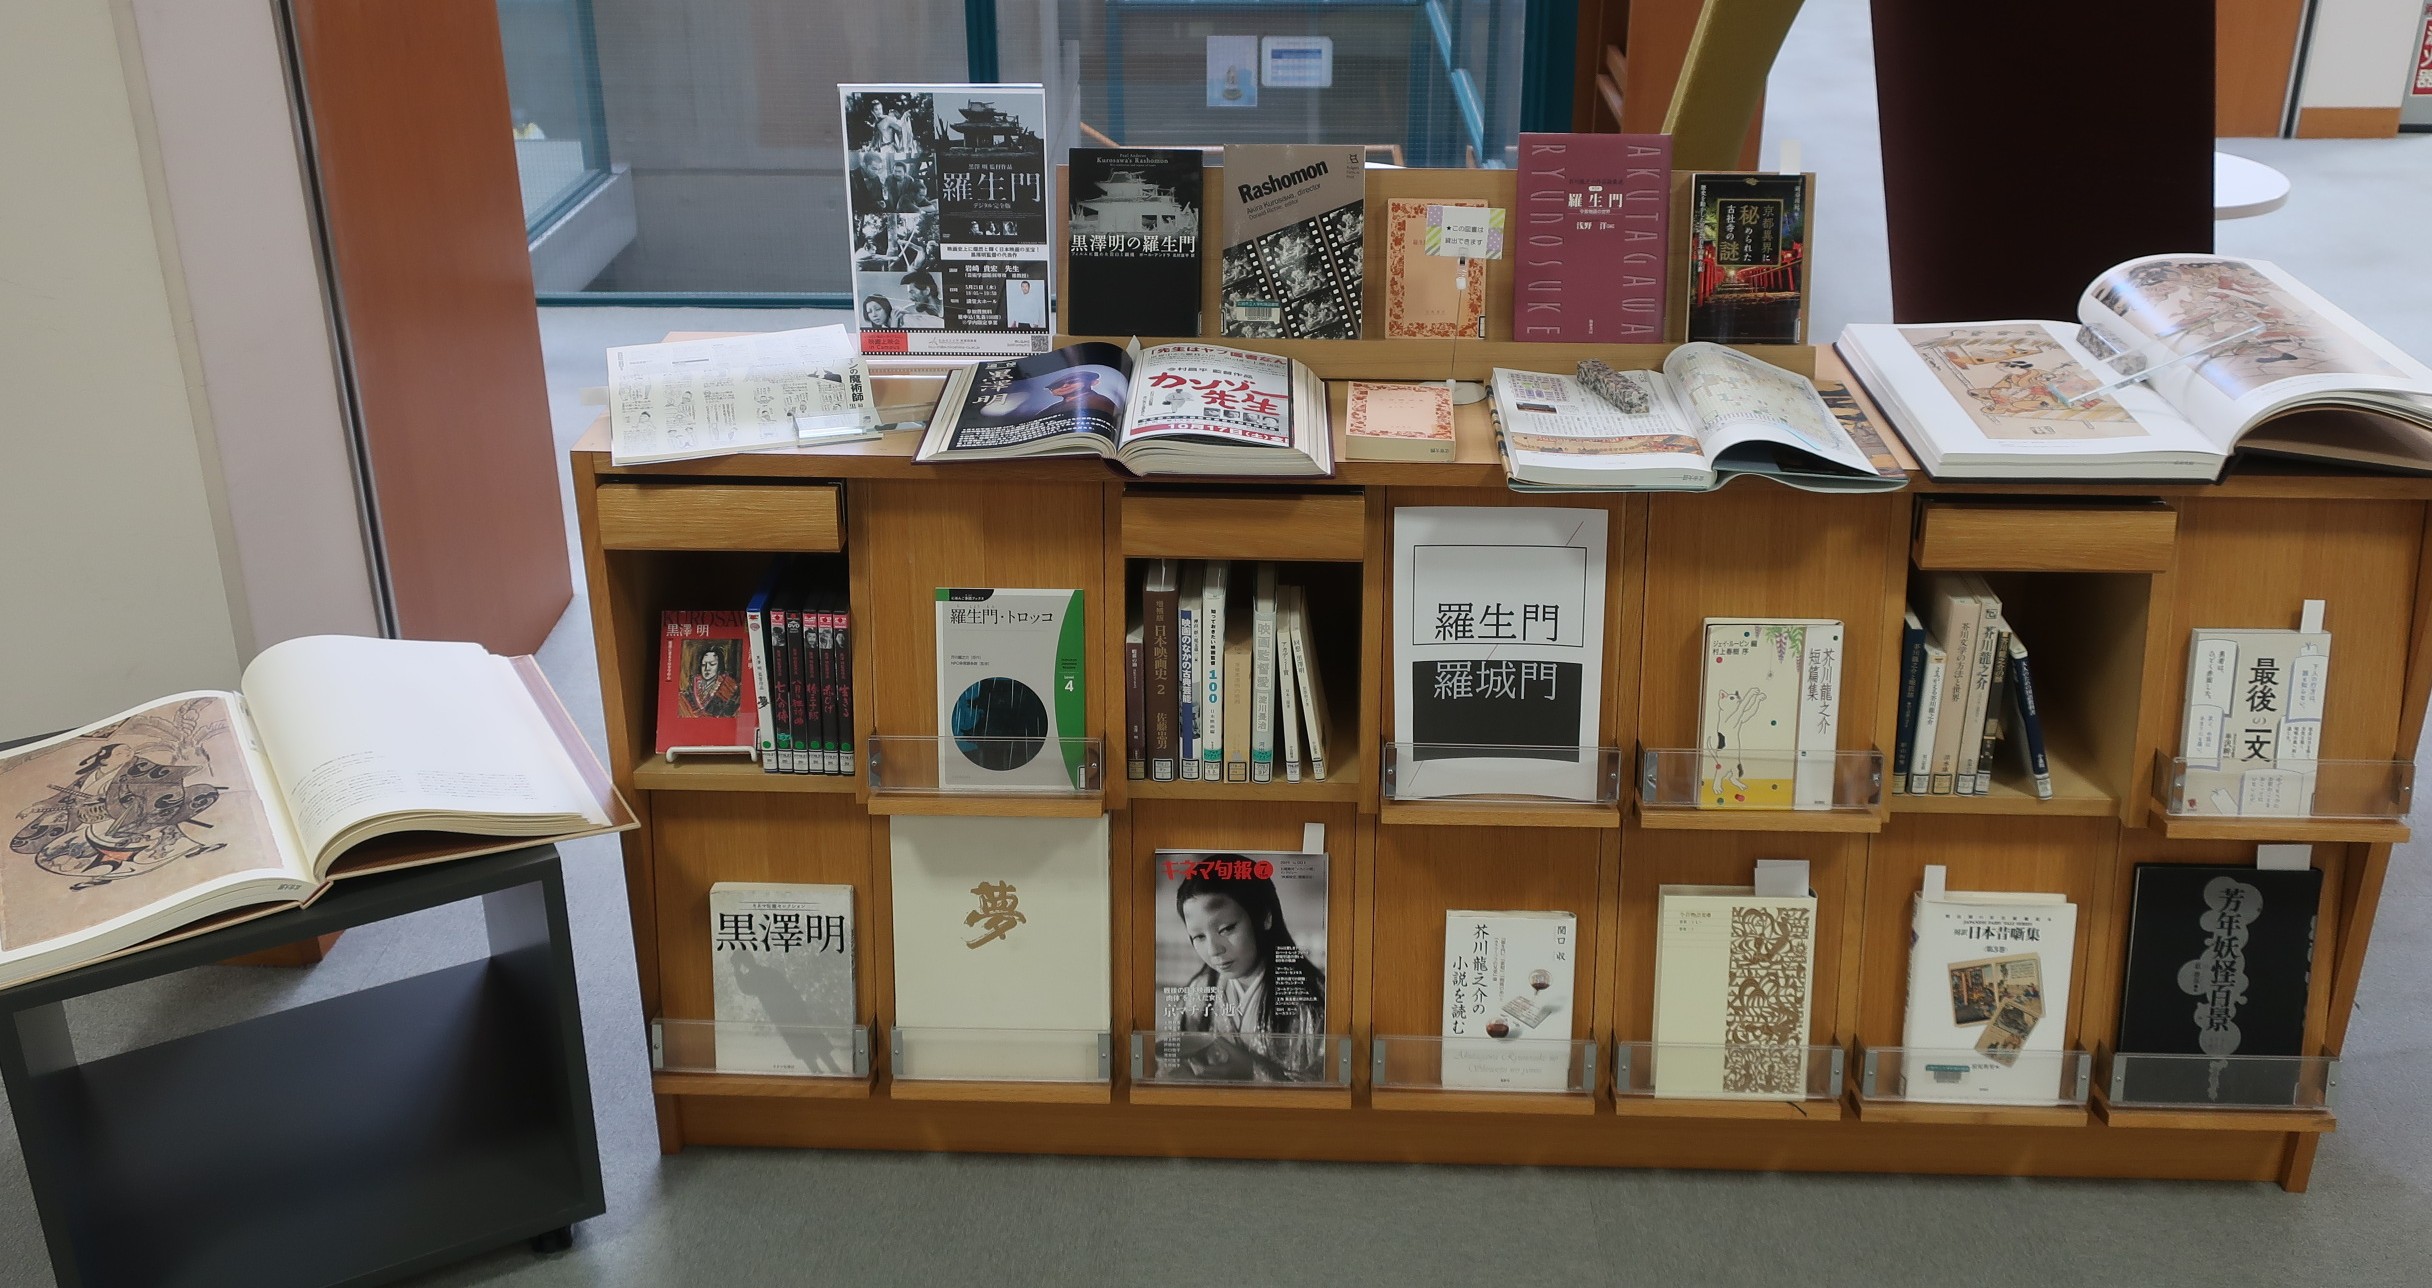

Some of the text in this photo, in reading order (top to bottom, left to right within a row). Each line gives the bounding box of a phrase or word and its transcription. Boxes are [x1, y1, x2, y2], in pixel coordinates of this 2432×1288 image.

[942, 172, 1040, 202] 羅生門
[1238, 160, 1328, 204] Rashomon
[1247, 204, 1263, 215] Akira
[1297, 183, 1321, 196] director
[1568, 193, 1623, 208] 羅生門
[1284, 200, 1299, 208] editor
[1070, 234, 1196, 253] 黒澤明の羅生門
[1527, 144, 1566, 334] RYUNOSUKE
[1621, 145, 1662, 334] AKUTAGAWA
[1720, 204, 1740, 261] 古社寺の謎
[1739, 205, 1760, 262] 秘められた
[1762, 206, 1774, 262] 京都異界に
[1005, 265, 1020, 273] 先生
[1148, 372, 1288, 399] カンゾー
[1201, 390, 1280, 416] 先生
[666, 623, 709, 637] 黒澤 明
[950, 608, 1053, 624] 羅生門・トロッコ
[1435, 602, 1560, 642] 羅生門
[1154, 625, 1168, 695] 日本映画史 2
[1182, 618, 1192, 704] 映画のなかの古典芸能
[1257, 622, 1271, 690] 映画監督愛
[1712, 648, 1749, 656] 村上春樹 序
[1713, 640, 1749, 648] ジェイ・ルービン
[1976, 626, 1996, 691] 芥川龍之介
[1064, 680, 1074, 692] 4
[1209, 670, 1217, 703] 100
[1434, 660, 1558, 700] 羅城門
[1807, 648, 1821, 701] 短篇集
[1818, 648, 1835, 735] 芥川龍之介
[757, 696, 769, 709] 夢
[775, 681, 789, 723] 七人の侍
[822, 685, 834, 714] 赤ひげ
[839, 685, 850, 718] 生きる
[2241, 658, 2280, 763] 最後の一文
[1156, 712, 1168, 749] 佐藤忠男
[1162, 860, 1252, 880] キネマ旬報
[716, 913, 845, 954] 黒澤明
[961, 880, 1026, 950] 夢
[1969, 926, 2040, 941] 日本昔噺集
[1556, 925, 1566, 961] 関口 収
[2206, 888, 2244, 1032] 芳年妖怪百景
[1472, 924, 1489, 1015] 芥川龍之介の
[1164, 1003, 1243, 1017] 京マチ子、逝く
[1452, 956, 1468, 1035] 小説を読む
